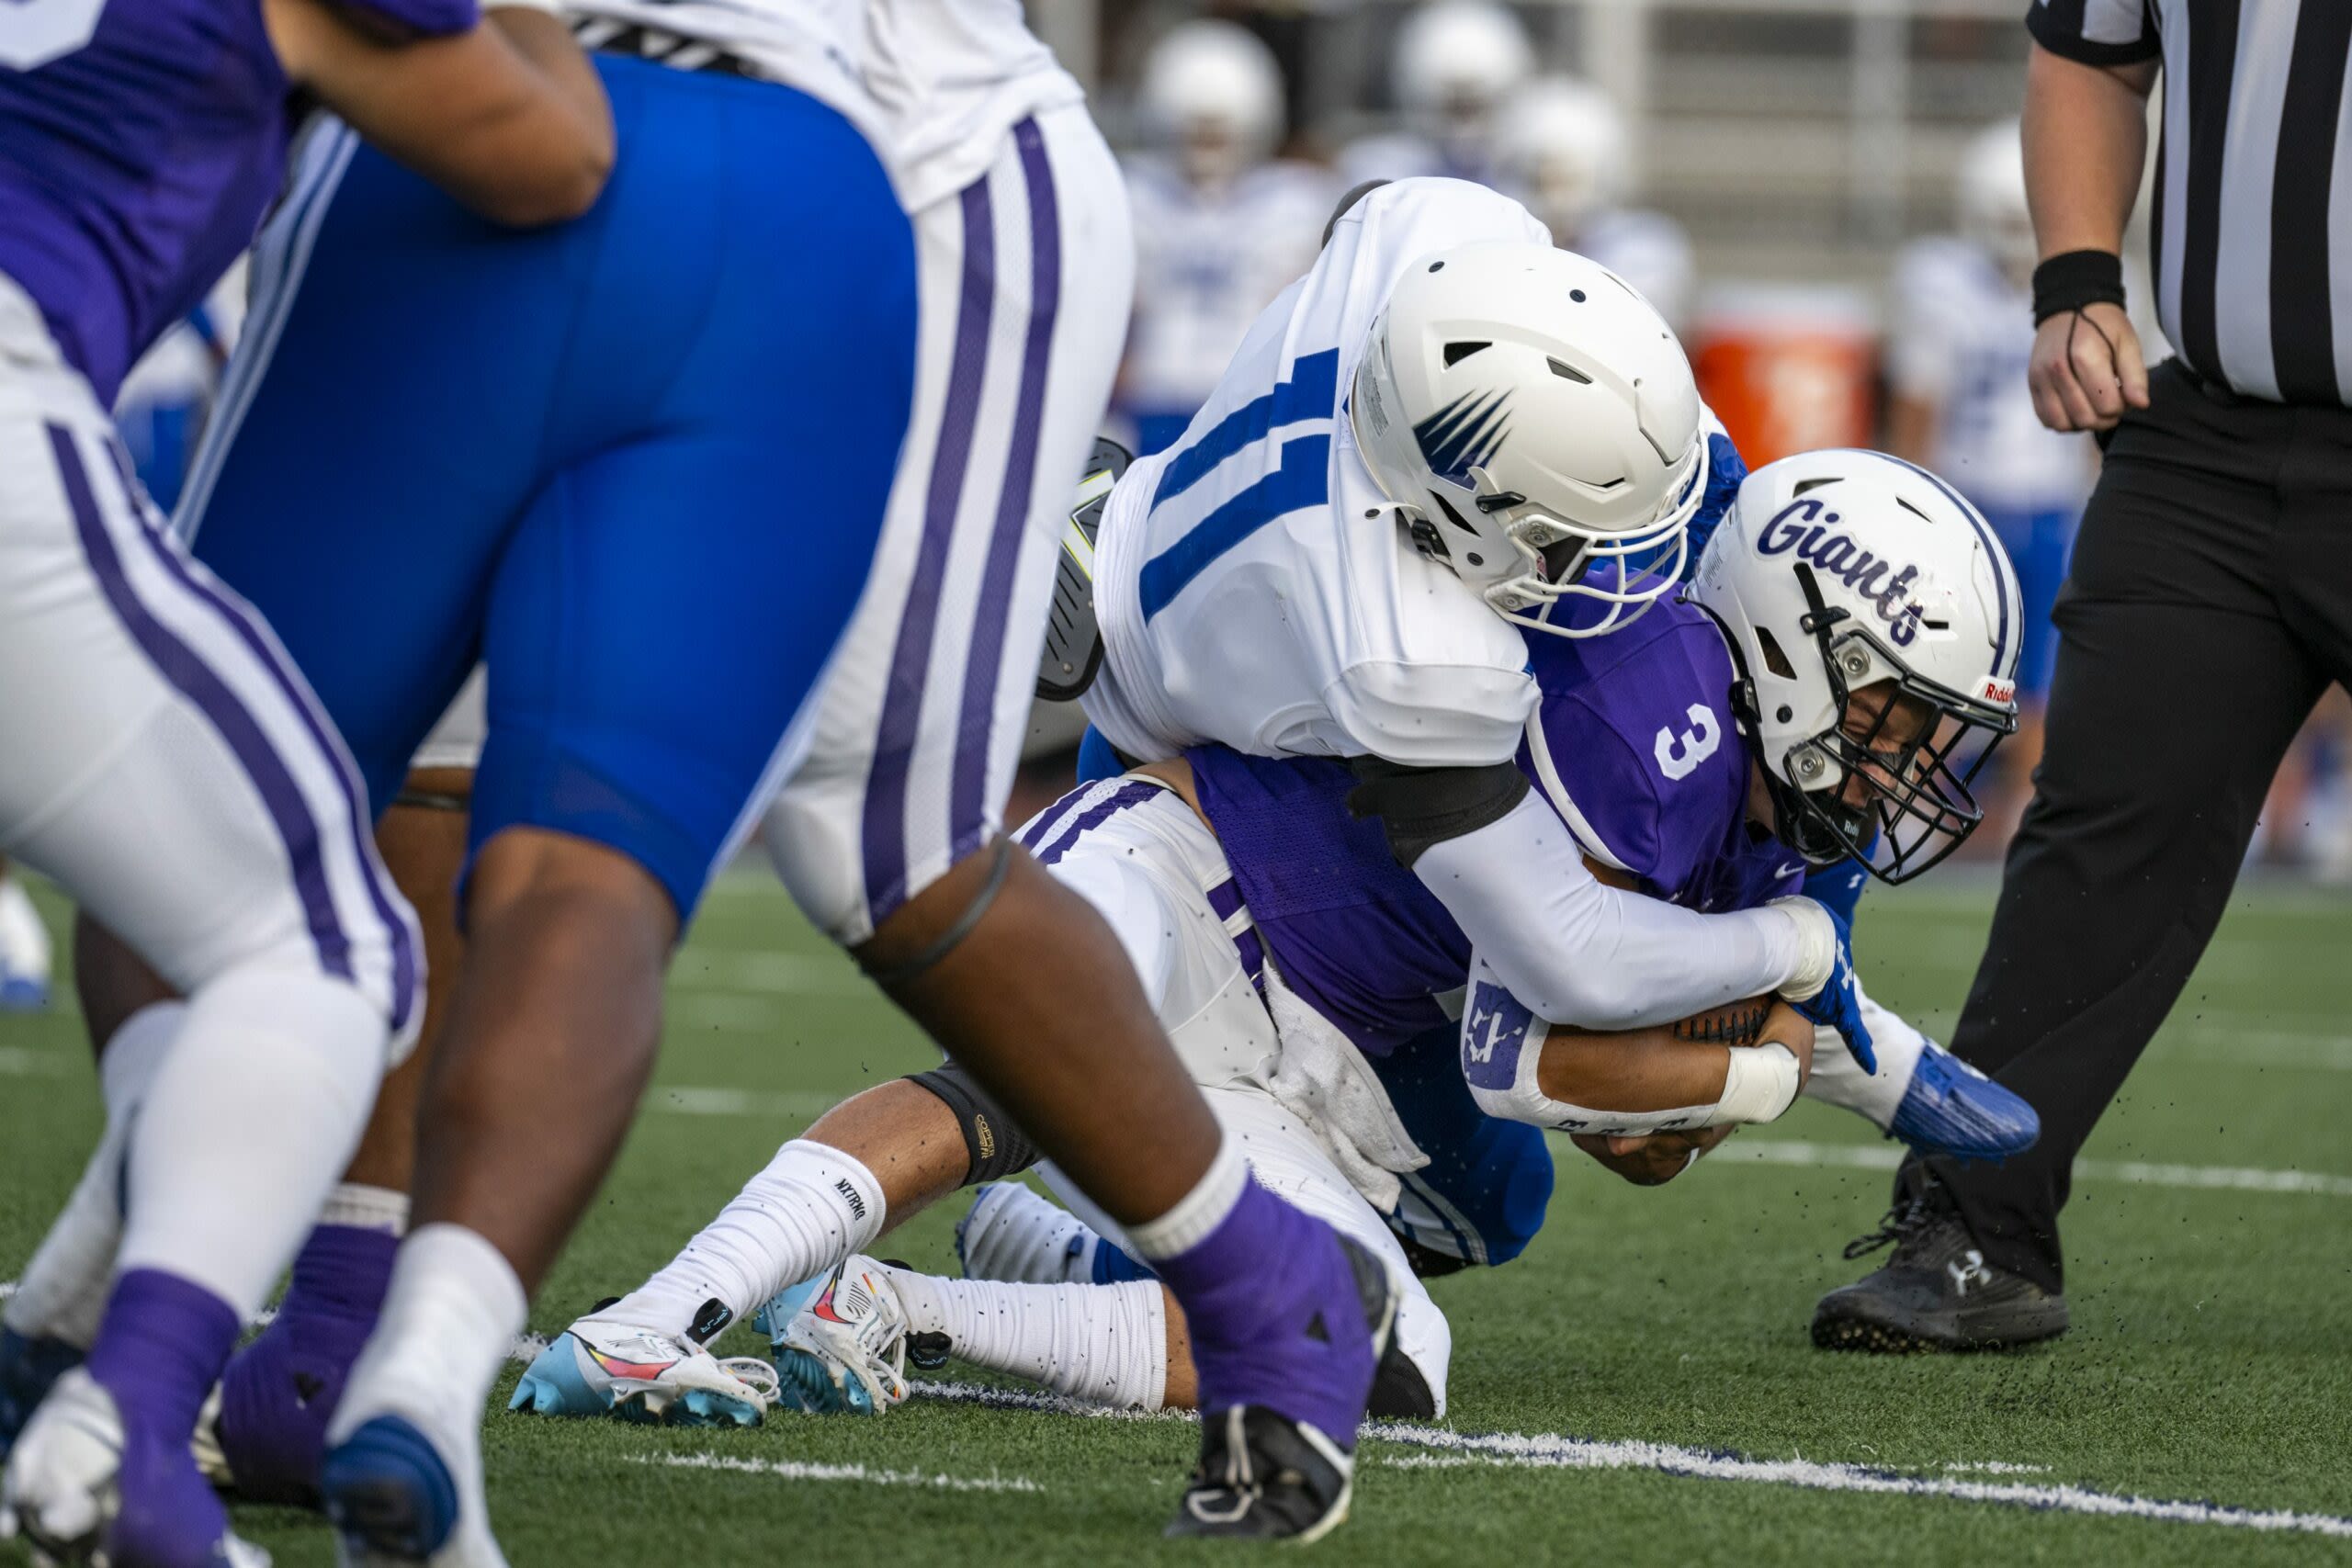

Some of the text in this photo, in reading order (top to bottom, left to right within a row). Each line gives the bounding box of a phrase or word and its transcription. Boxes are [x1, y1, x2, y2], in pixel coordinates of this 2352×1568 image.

[1758, 499, 1924, 648] Giants
[1655, 703, 1722, 782] 3
[977, 1113, 995, 1156] COPPER
